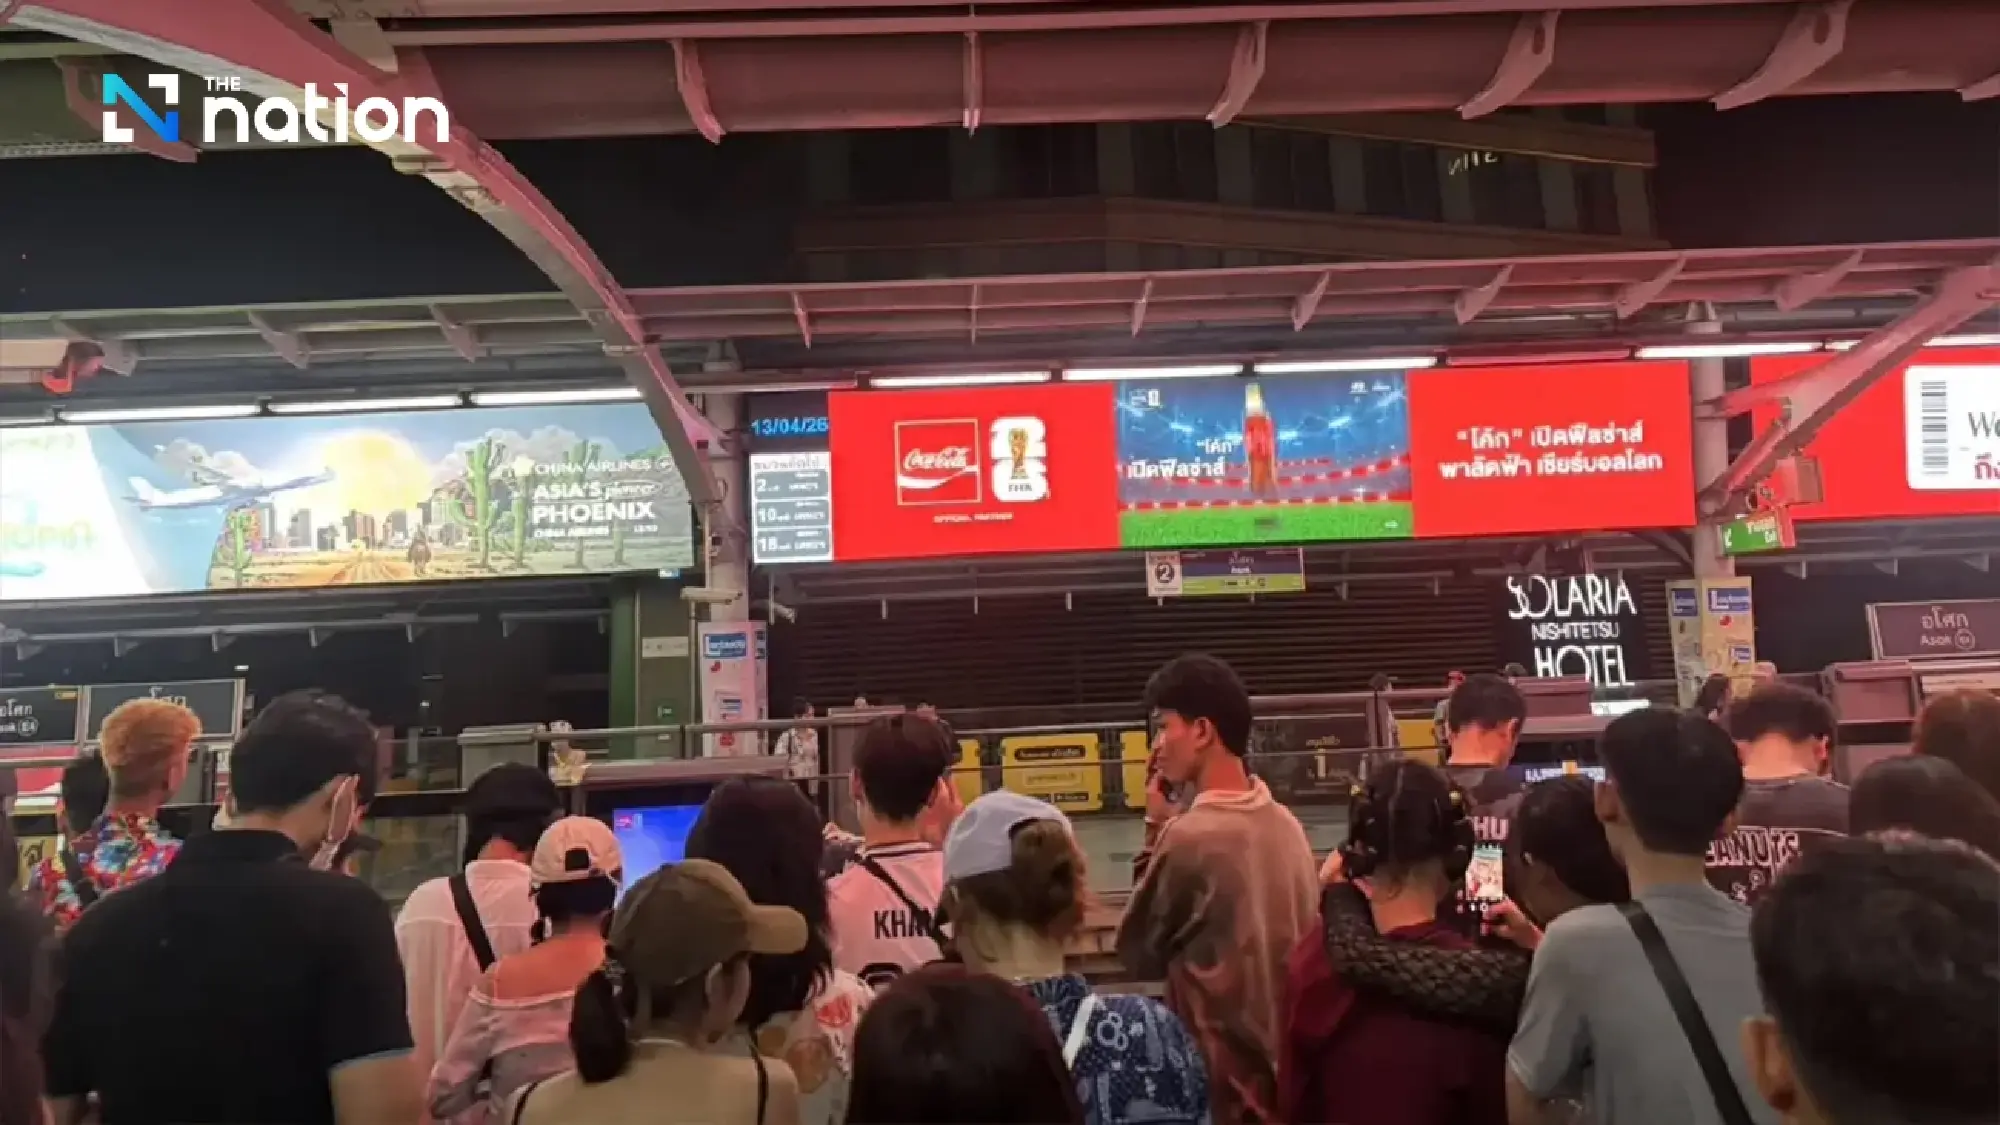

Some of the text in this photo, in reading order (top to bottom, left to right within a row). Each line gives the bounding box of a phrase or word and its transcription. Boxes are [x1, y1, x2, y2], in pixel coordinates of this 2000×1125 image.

[751, 416, 829, 435] 13/04/26
[535, 459, 651, 475] CHINA AIRLINES
[903, 446, 972, 471] Coca-Cola
[533, 480, 601, 500] ASIA'S
[532, 500, 657, 524] PHOENIX
[1158, 564, 1171, 581] 2
[1507, 573, 1638, 619] SOLARIA
[1920, 605, 1970, 629] อโศก
[1531, 621, 1620, 640] NISHITETSU
[1534, 644, 1636, 689] HOTEL
[1465, 815, 1509, 841] HU
